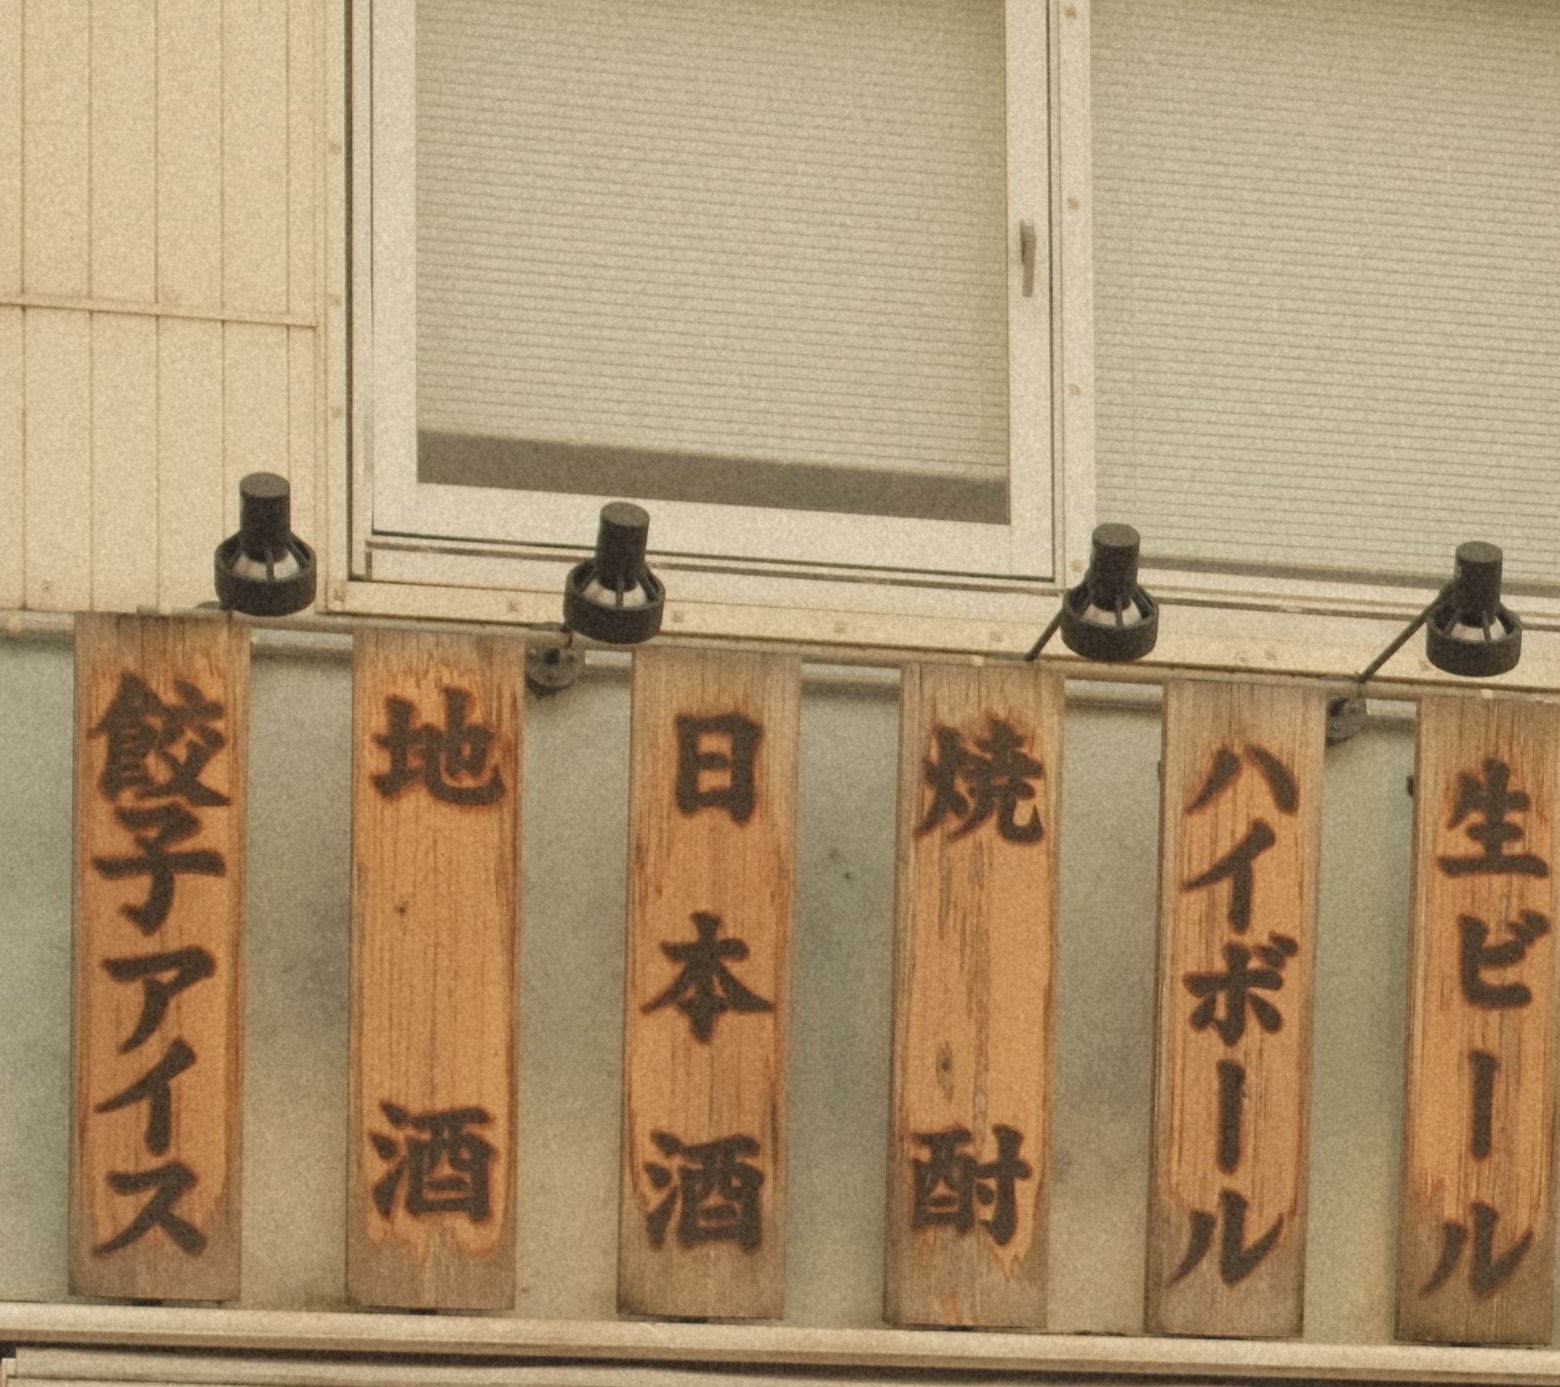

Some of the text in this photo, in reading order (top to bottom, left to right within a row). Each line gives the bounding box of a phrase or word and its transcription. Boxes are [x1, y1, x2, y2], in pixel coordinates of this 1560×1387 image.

[90, 670, 233, 1264] 餃子アイス
[370, 686, 506, 1228] 地酒
[640, 712, 777, 1253] 日本酒
[912, 716, 1047, 1246] 焼酎
[1169, 744, 1300, 1290] ハイボール
[1422, 761, 1550, 1298] 生ビール
